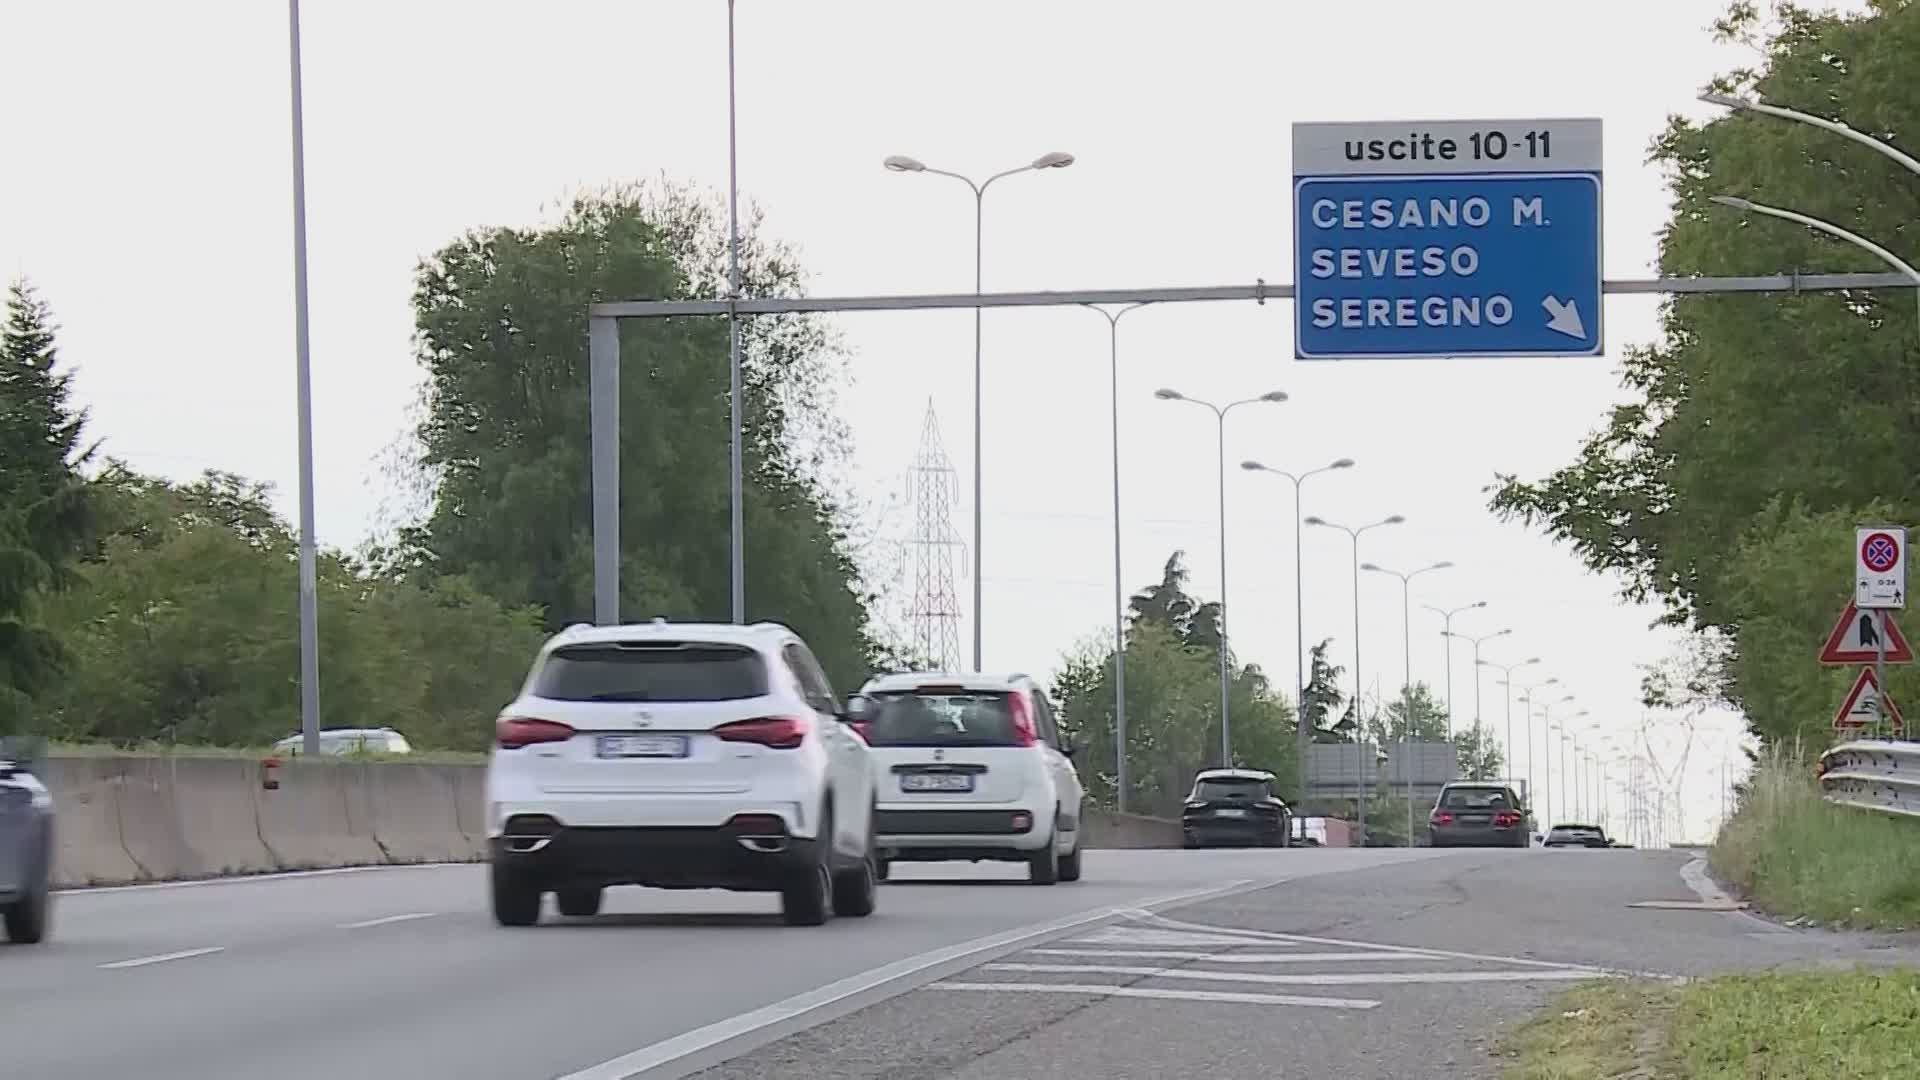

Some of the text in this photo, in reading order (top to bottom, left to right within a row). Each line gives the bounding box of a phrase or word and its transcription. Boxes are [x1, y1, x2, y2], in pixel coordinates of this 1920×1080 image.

[1344, 130, 1551, 161] uscite 10-11
[1312, 197, 1551, 228] CESANO M.
[1311, 246, 1479, 278] SEVESO
[1312, 295, 1513, 328] SEREGNO
